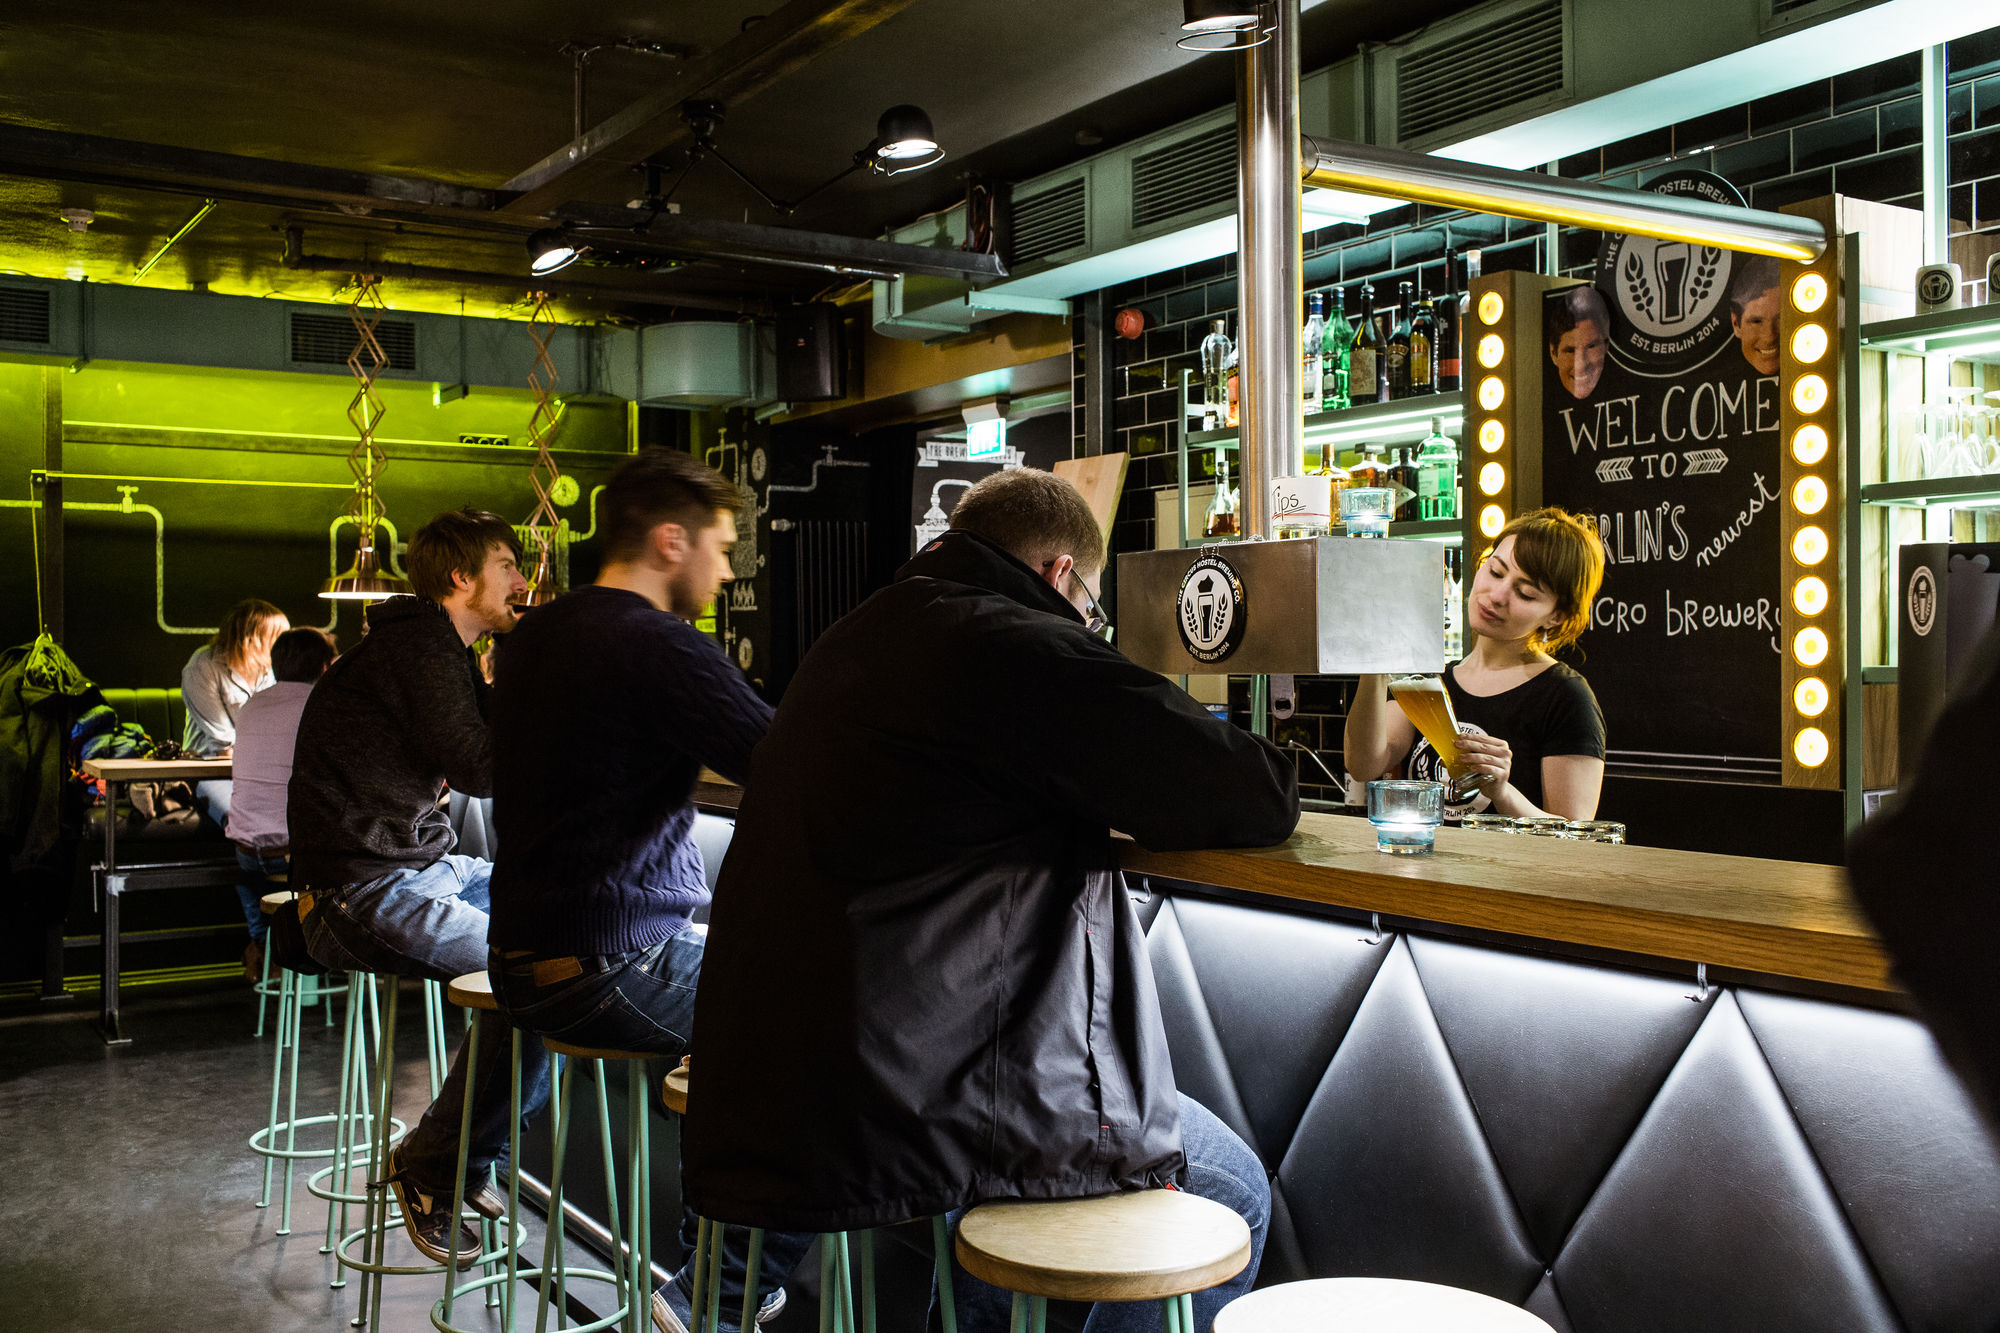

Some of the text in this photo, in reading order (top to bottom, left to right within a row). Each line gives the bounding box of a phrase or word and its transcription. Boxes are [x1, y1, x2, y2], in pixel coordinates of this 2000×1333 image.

[1604, 242, 1619, 270] THE
[1630, 316, 1720, 354] EST. BERLIN 2014
[1558, 376, 1780, 455] WELCOME
[945, 446, 966, 458] BREW
[1640, 451, 1677, 479] TO
[1272, 485, 1299, 521] Tips
[1696, 471, 1781, 568] newest
[1584, 500, 1689, 564] RLIN'S
[1181, 564, 1197, 588] CIRCUS
[1196, 558, 1218, 568] HOSTEL
[1217, 560, 1237, 589] BREWING
[1589, 596, 1647, 633] ICRO
[1199, 650, 1219, 660] BERLIN
[1218, 641, 1230, 655] 2014
[1444, 809, 1462, 817] ERLIN
